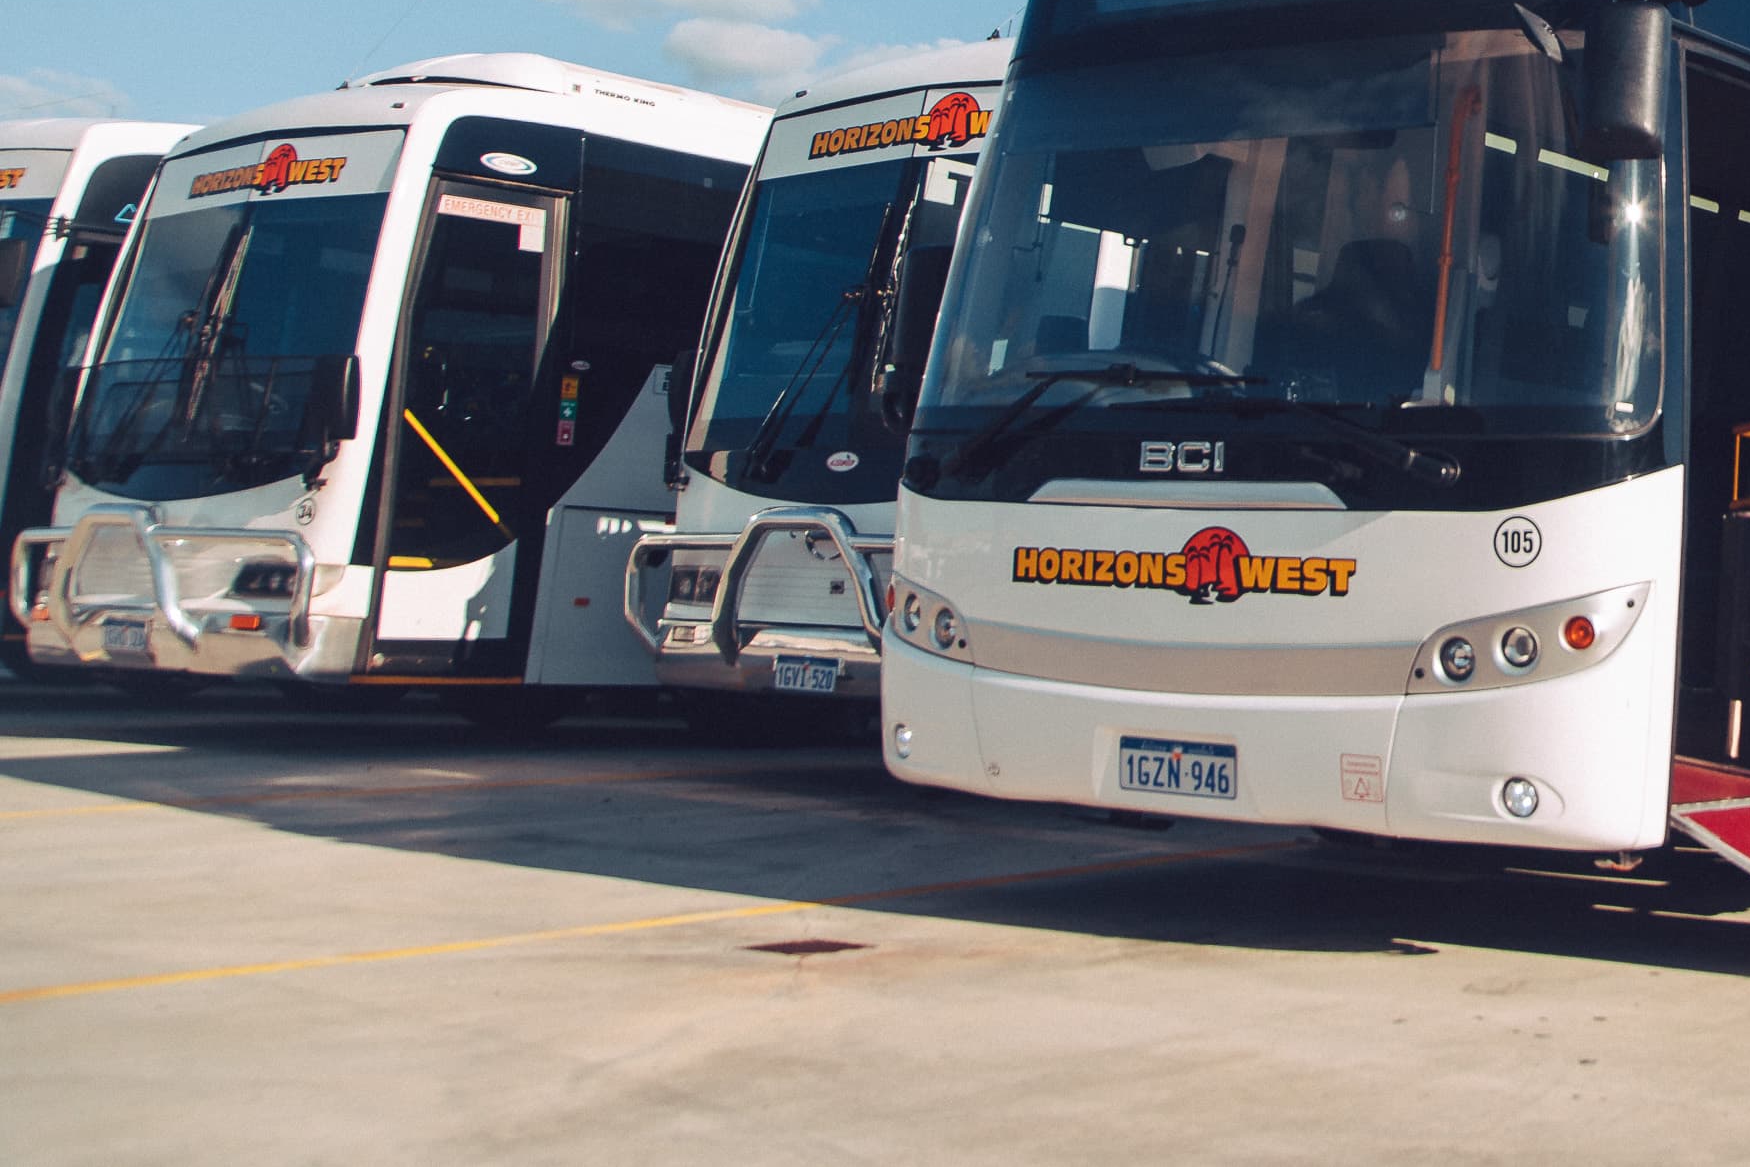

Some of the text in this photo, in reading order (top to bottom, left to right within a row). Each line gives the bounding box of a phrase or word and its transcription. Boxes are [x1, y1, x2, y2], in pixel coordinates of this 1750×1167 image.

[594, 89, 656, 107] THERMO KING
[808, 115, 932, 160] HORIZONS
[188, 156, 347, 199] HORIZONS WEST
[444, 198, 513, 220] EMERGENCY
[1139, 440, 1225, 473] BCI
[298, 504, 313, 520] 34
[1502, 530, 1534, 554] 105
[1013, 547, 1356, 597] HORIZONS WEST
